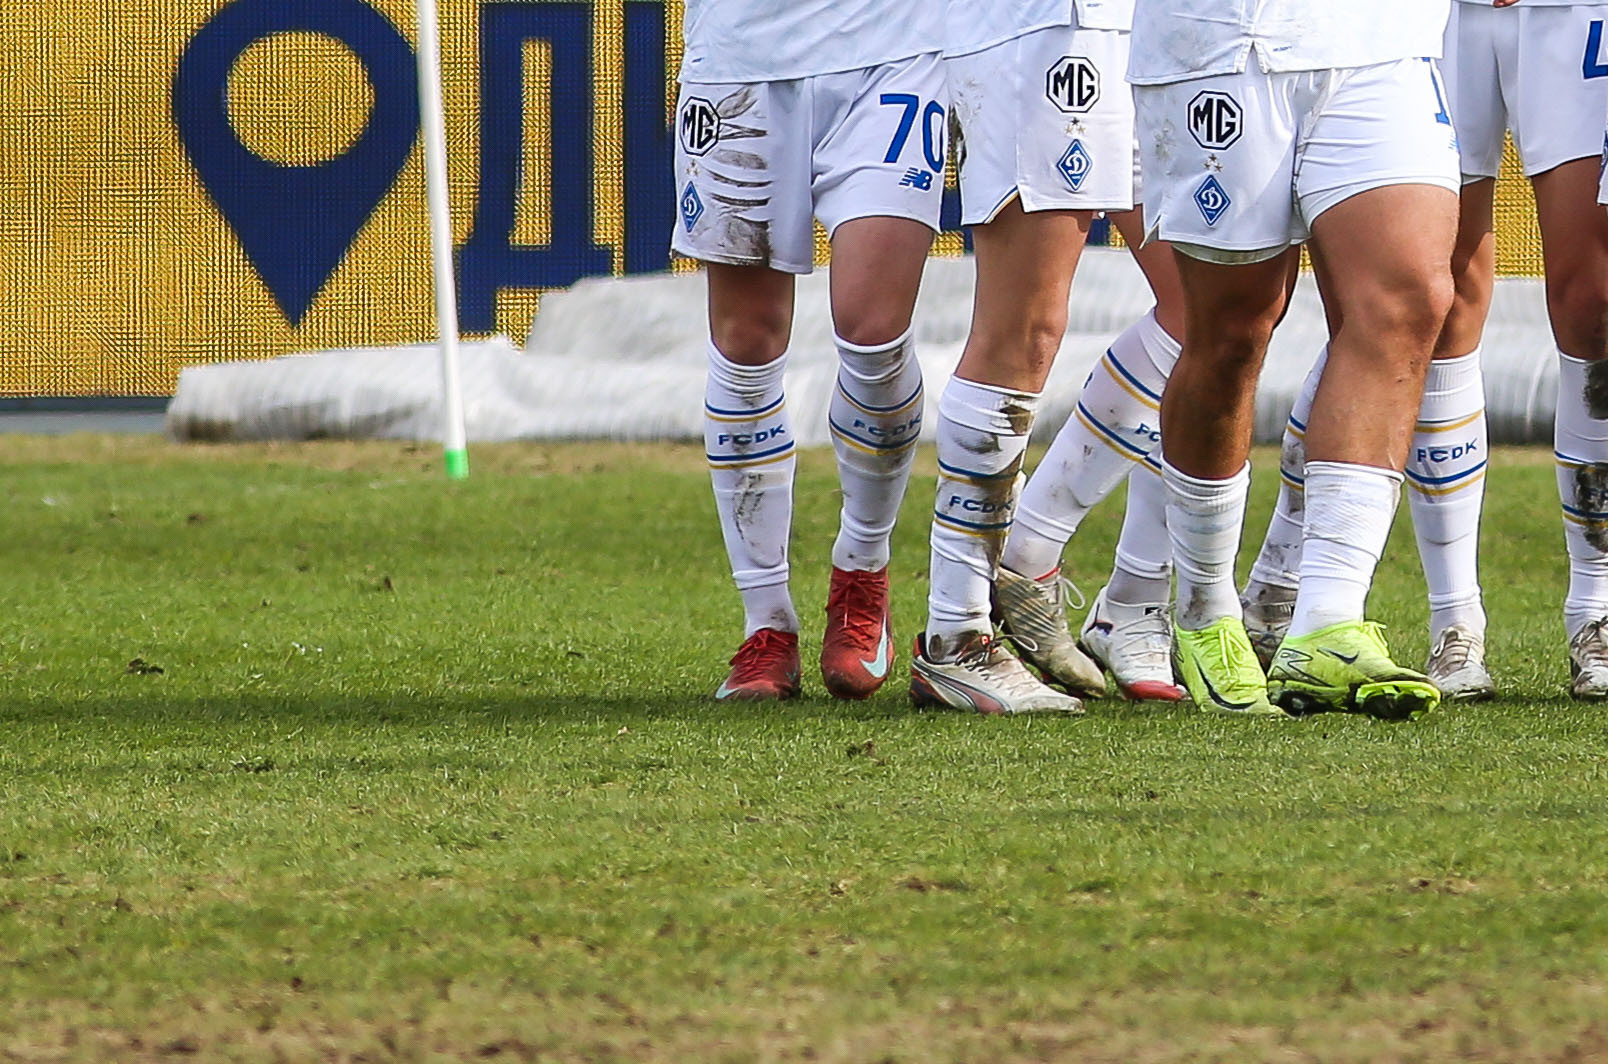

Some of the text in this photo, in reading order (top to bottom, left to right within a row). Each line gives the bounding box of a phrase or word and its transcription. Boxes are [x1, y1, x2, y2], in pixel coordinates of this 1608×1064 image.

[1052, 62, 1097, 107] MG
[682, 103, 716, 150] MG
[880, 93, 945, 173] 70
[1192, 97, 1237, 144] MG
[718, 422, 786, 447] FCDK
[853, 414, 921, 438] FCDK
[1135, 422, 1161, 443] FC
[1417, 438, 1478, 463] FCDK
